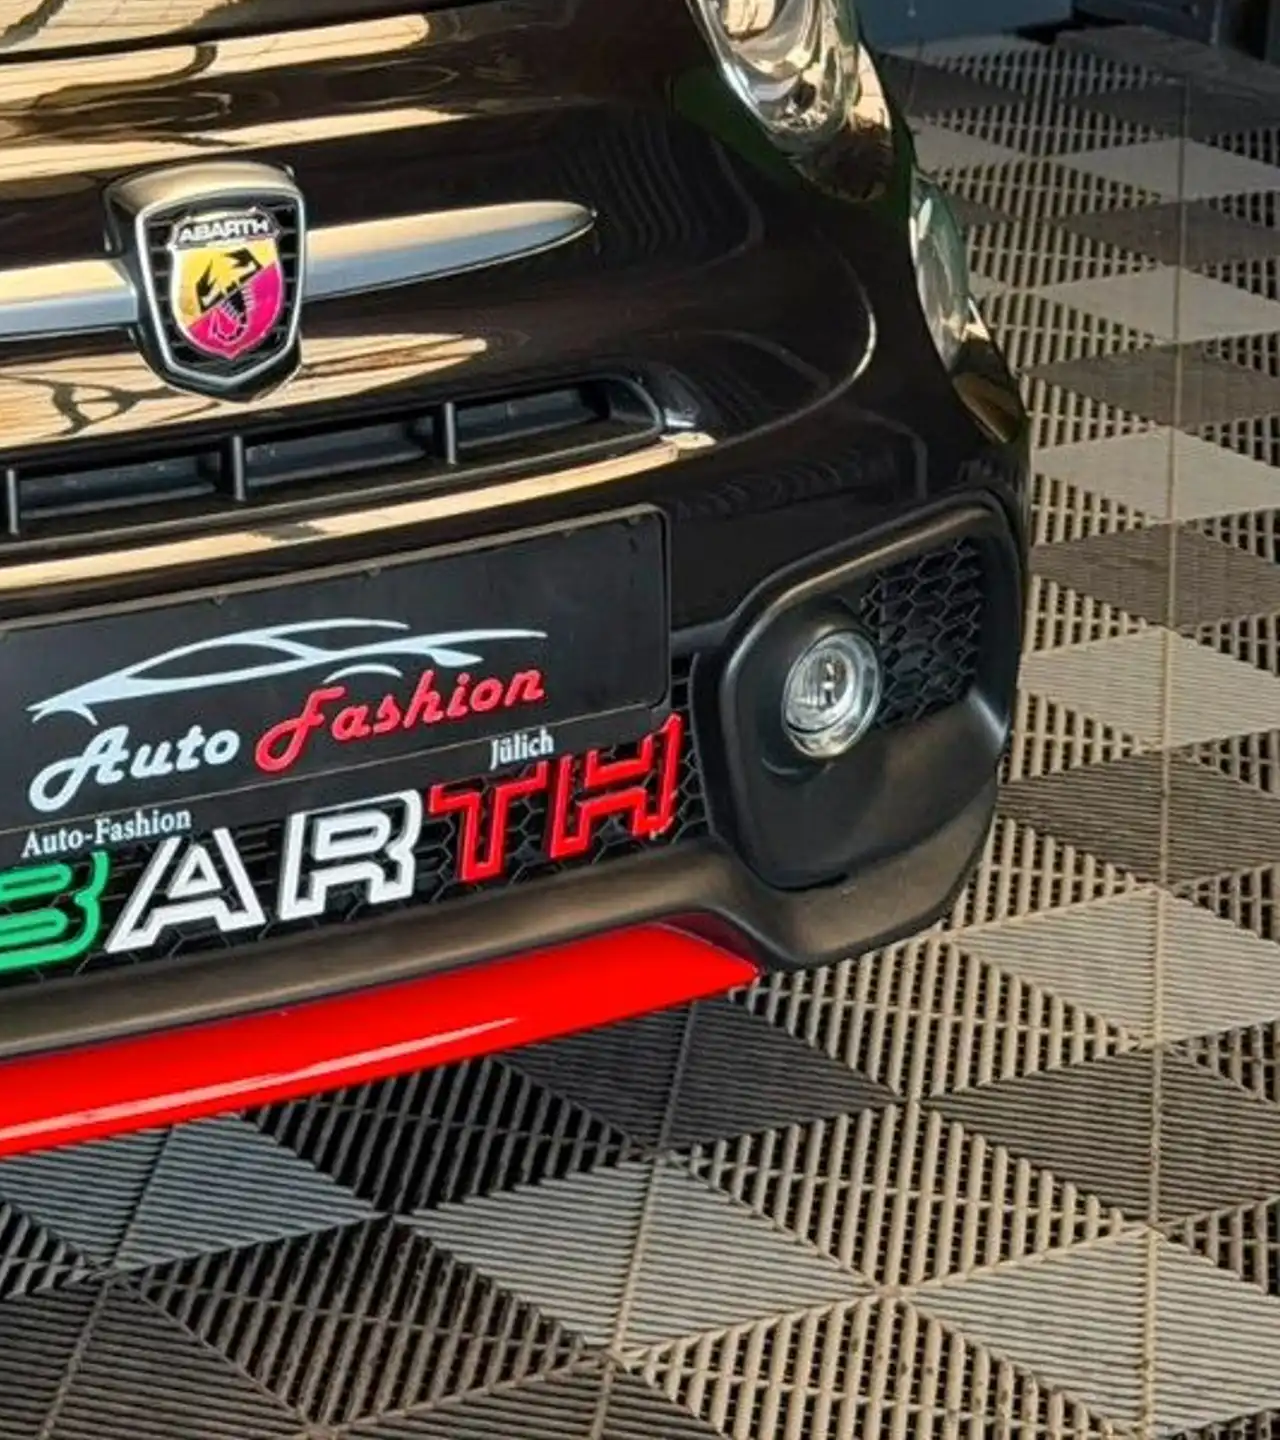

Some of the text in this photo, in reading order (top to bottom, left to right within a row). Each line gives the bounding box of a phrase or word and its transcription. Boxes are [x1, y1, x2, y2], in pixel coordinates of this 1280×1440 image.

[179, 219, 268, 242] ABARTH
[23, 727, 554, 859] Auto-Fashion Jülich
[28, 668, 545, 812] Auto Fashion
